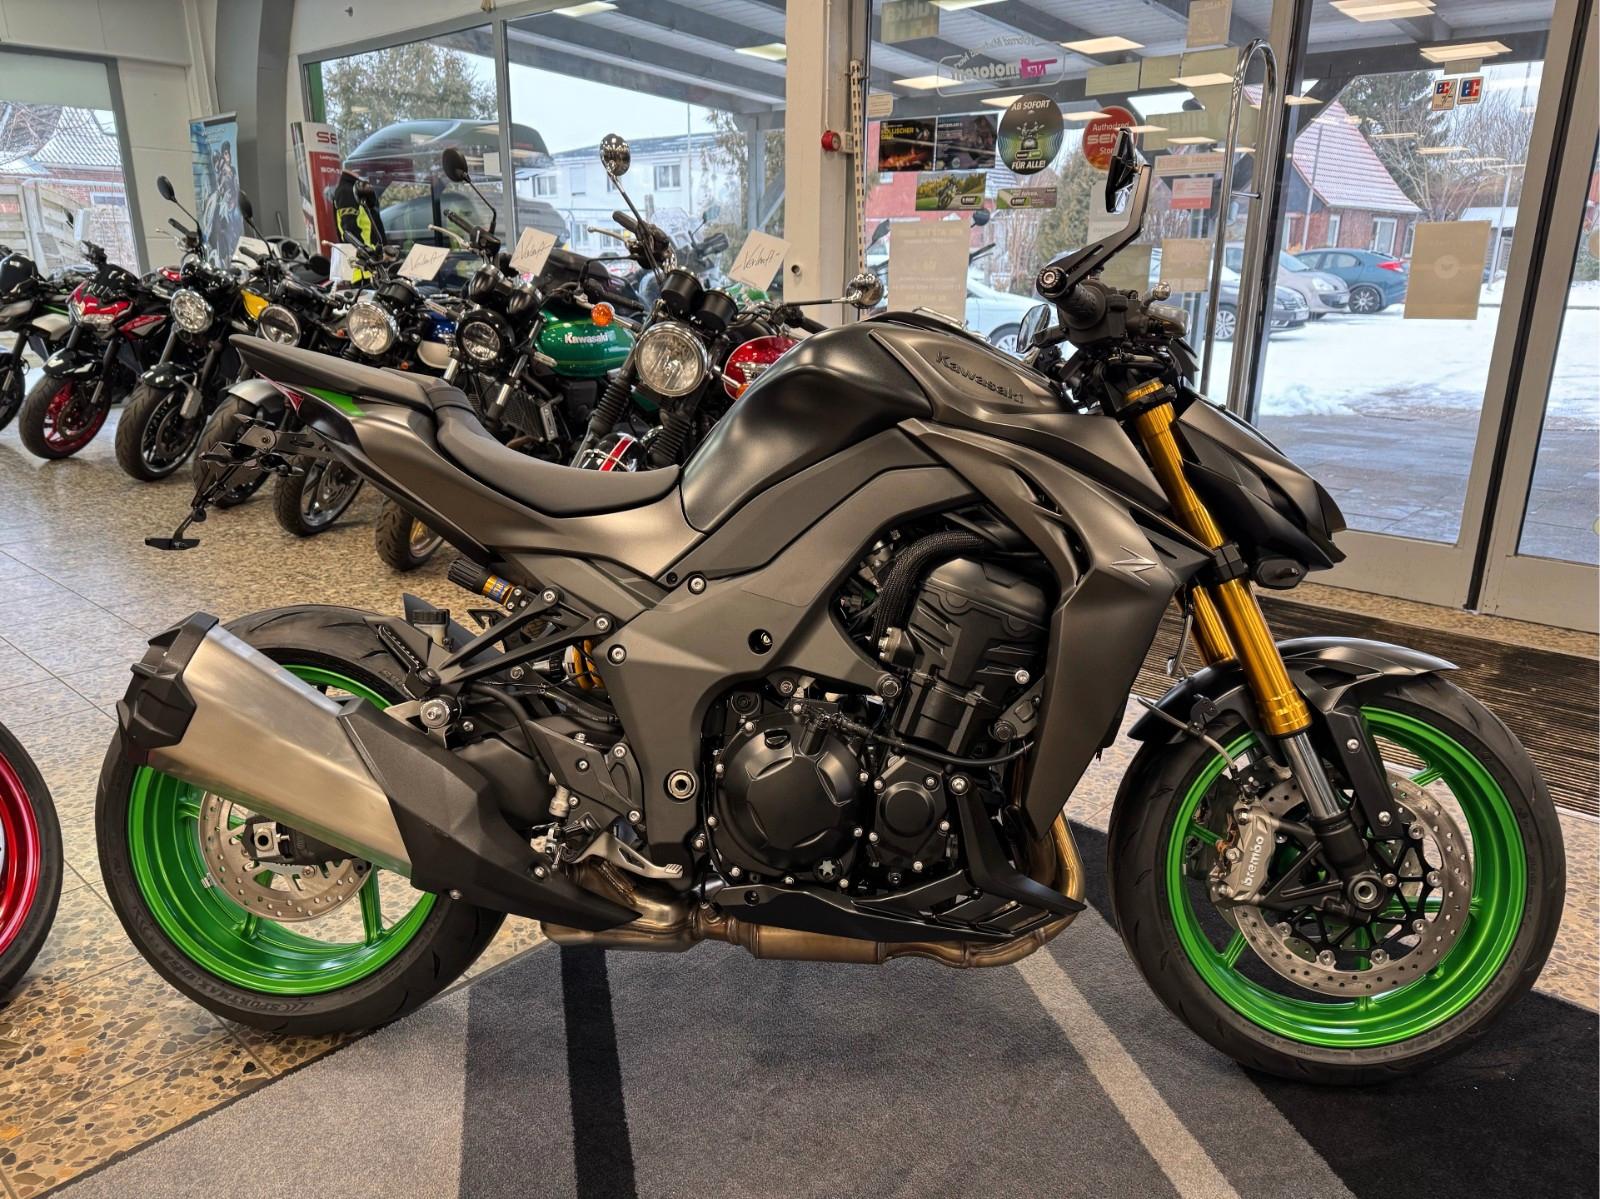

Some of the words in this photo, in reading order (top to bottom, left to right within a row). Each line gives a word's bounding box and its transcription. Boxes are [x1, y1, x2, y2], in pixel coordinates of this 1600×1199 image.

[1011, 102, 1022, 111] AB
[1022, 99, 1051, 110] SOFORT
[1087, 133, 1118, 145] SEN
[565, 331, 609, 344] Kawasaki
[936, 351, 1024, 404] Kawasaki
[1240, 836, 1265, 887] brembo
